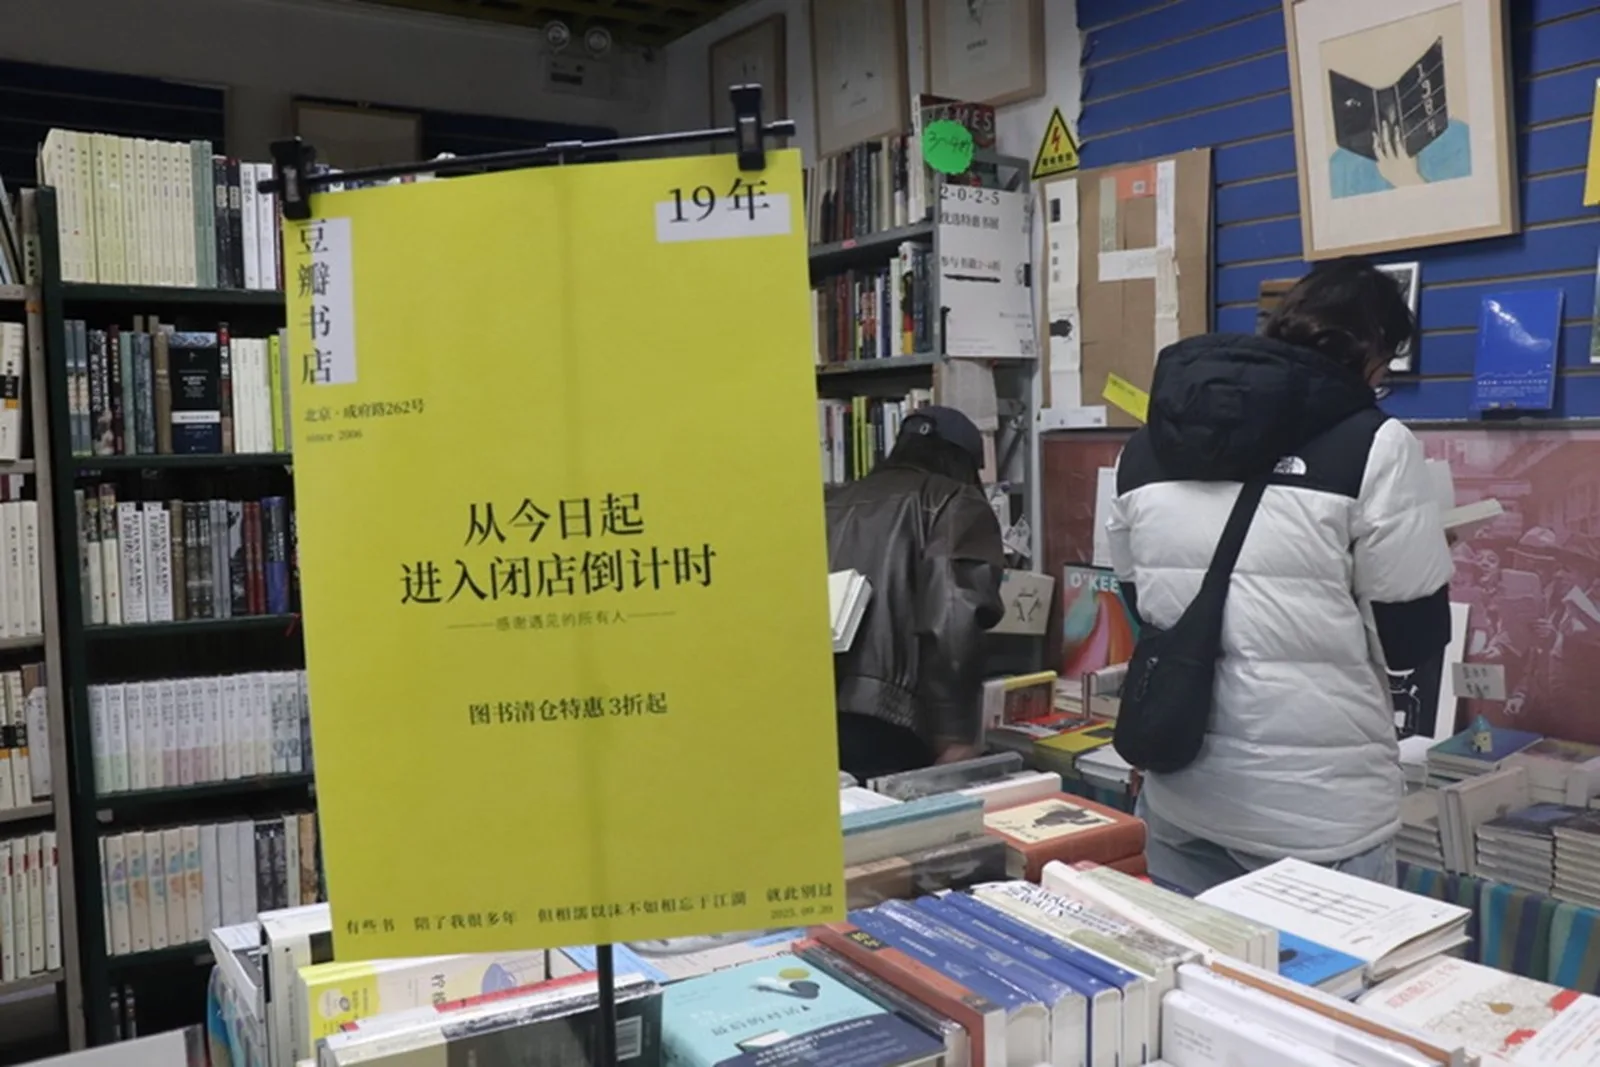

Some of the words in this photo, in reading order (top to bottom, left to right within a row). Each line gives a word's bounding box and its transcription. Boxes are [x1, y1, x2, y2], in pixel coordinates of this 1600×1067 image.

[1415, 62, 1438, 138] 1984
[668, 177, 771, 224] 19年
[297, 218, 334, 386] 豆瓣书店
[464, 492, 645, 547] 从今日起
[400, 543, 717, 605] 进入闭店倒计时
[496, 610, 627, 632] 感谢遇见的所有人
[346, 917, 395, 935] 有些书
[413, 910, 518, 932] 陪了我很多年
[537, 890, 747, 923] 但相濡以沫不如相忘于江湖
[766, 883, 833, 902] 就此别过
